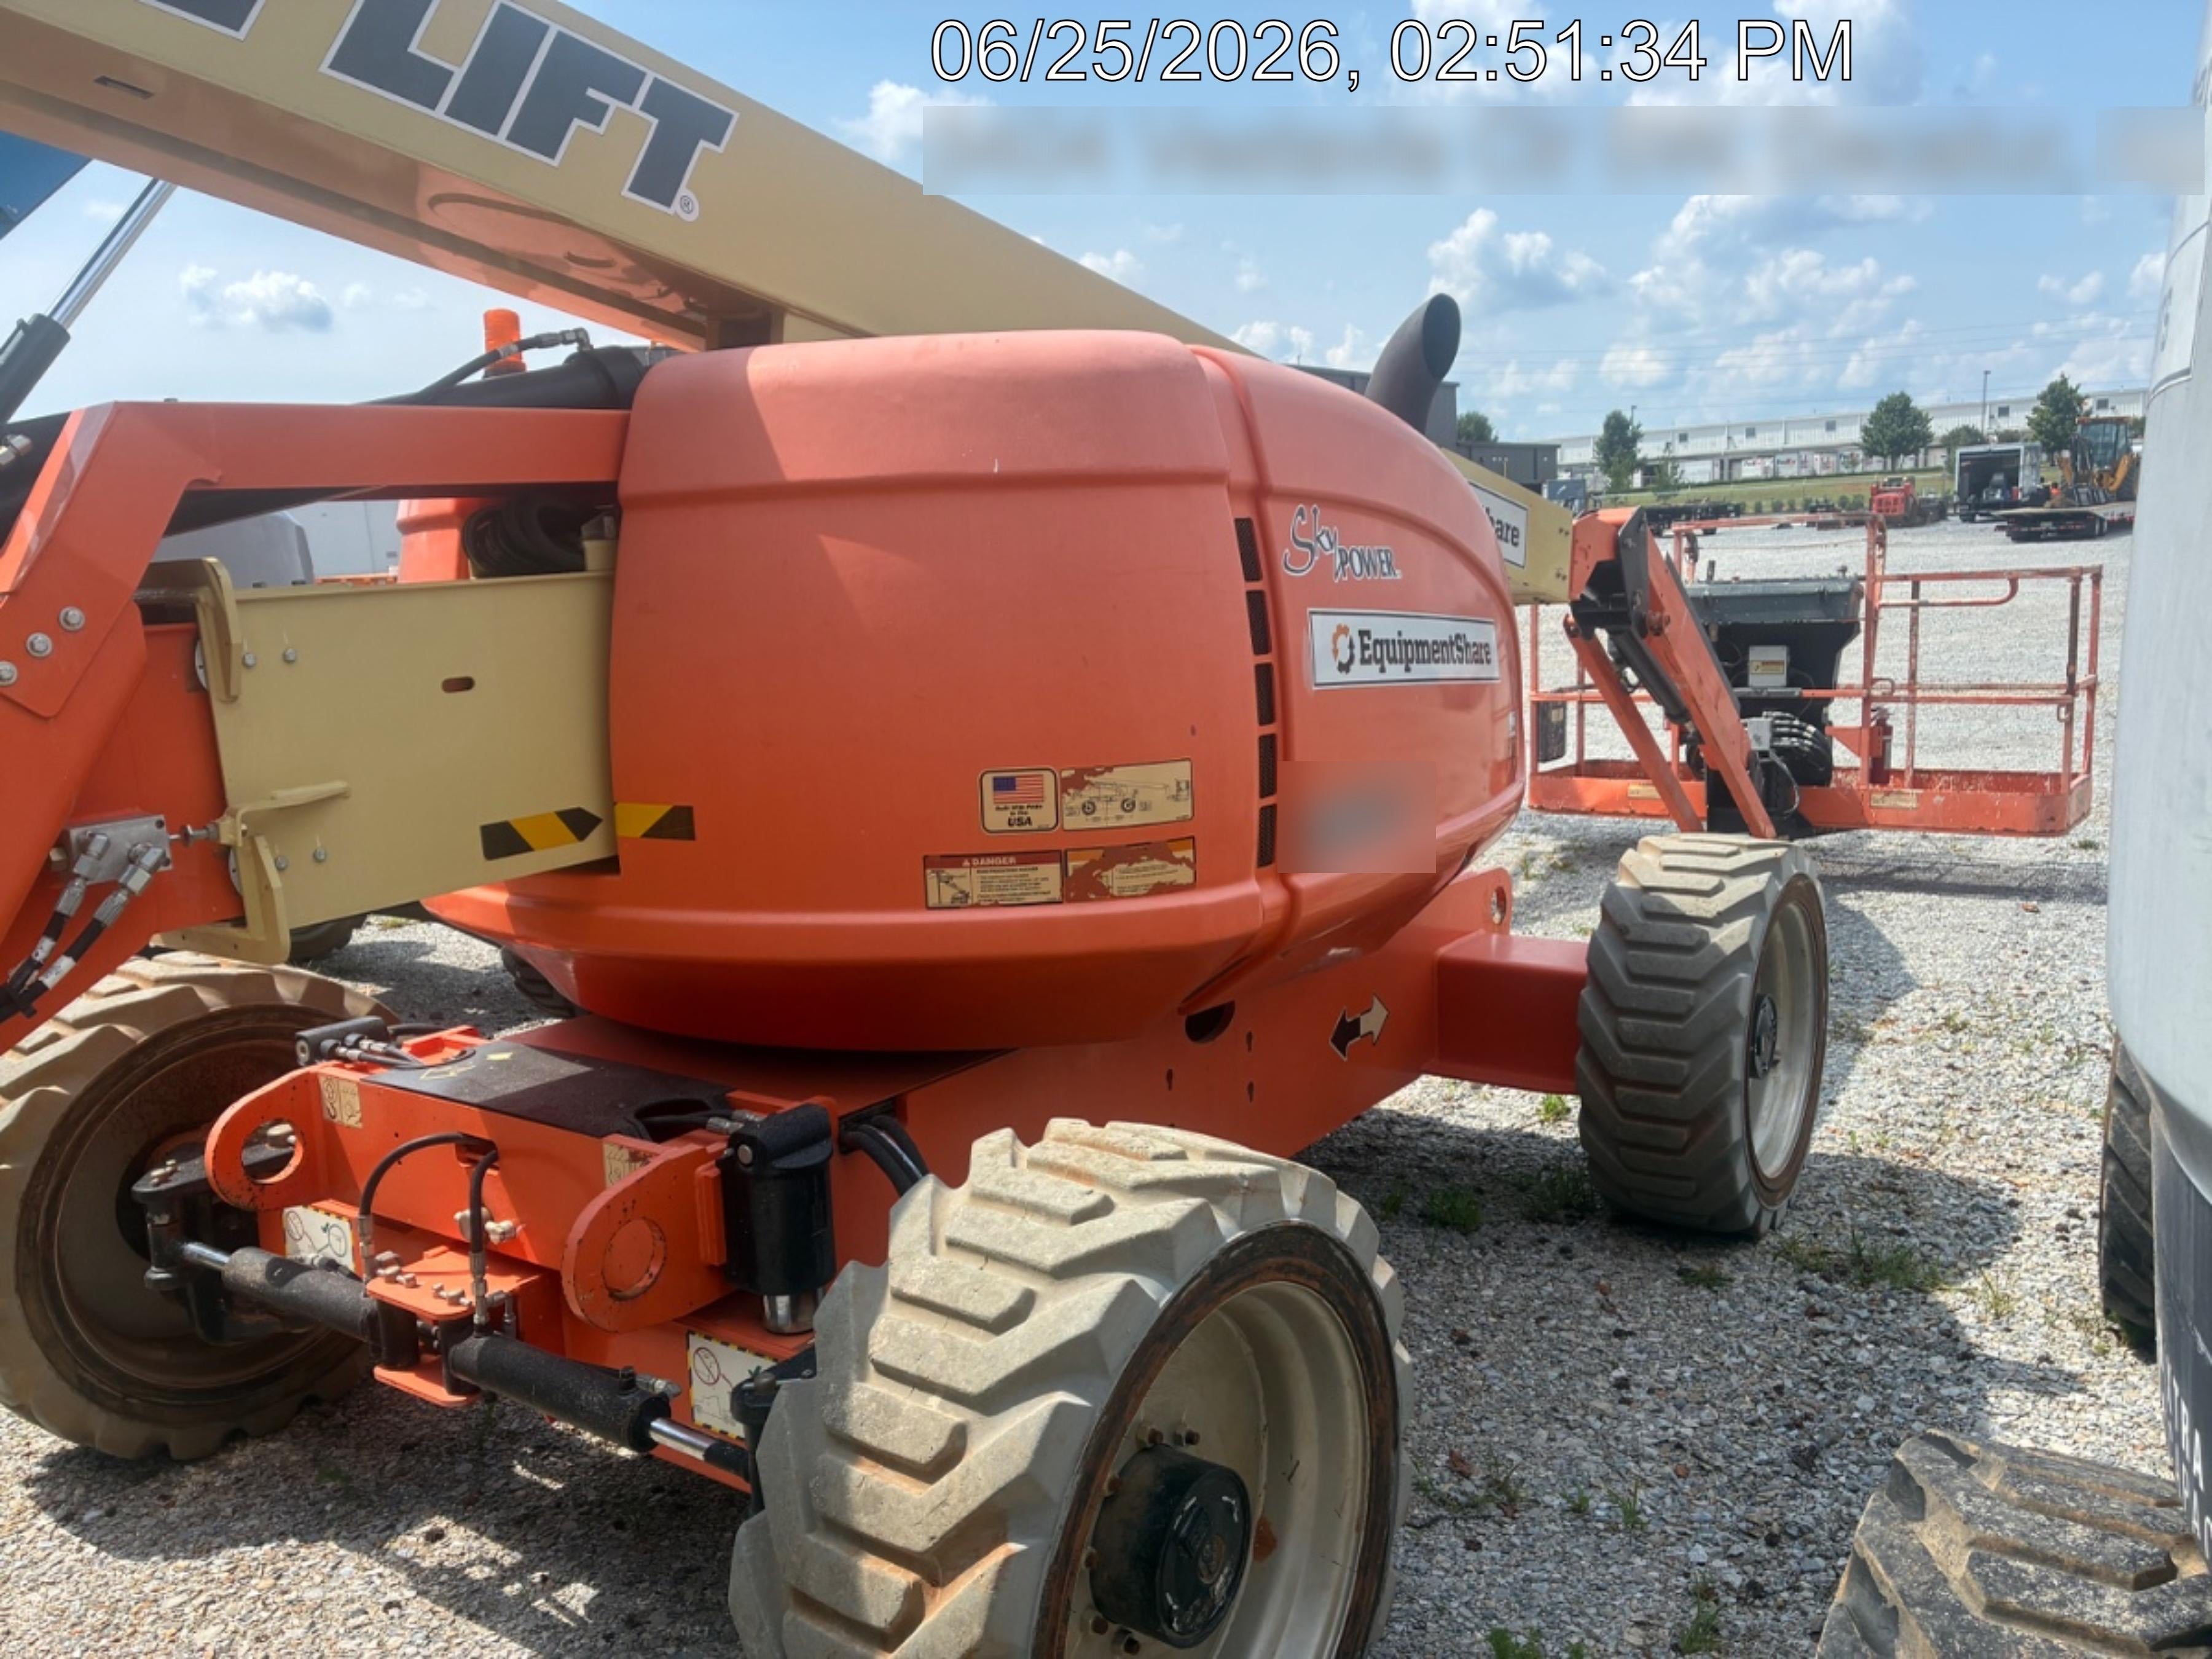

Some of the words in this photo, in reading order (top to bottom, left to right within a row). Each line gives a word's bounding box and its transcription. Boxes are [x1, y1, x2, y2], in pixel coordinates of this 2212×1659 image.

[320, 0, 738, 214] LIFT
[1284, 504, 1338, 582] Sky
[1333, 546, 1398, 581] POWER
[1358, 629, 1492, 673] EquipmentShare
[1008, 815, 1032, 828] USA
[972, 855, 1017, 866] DANGER
